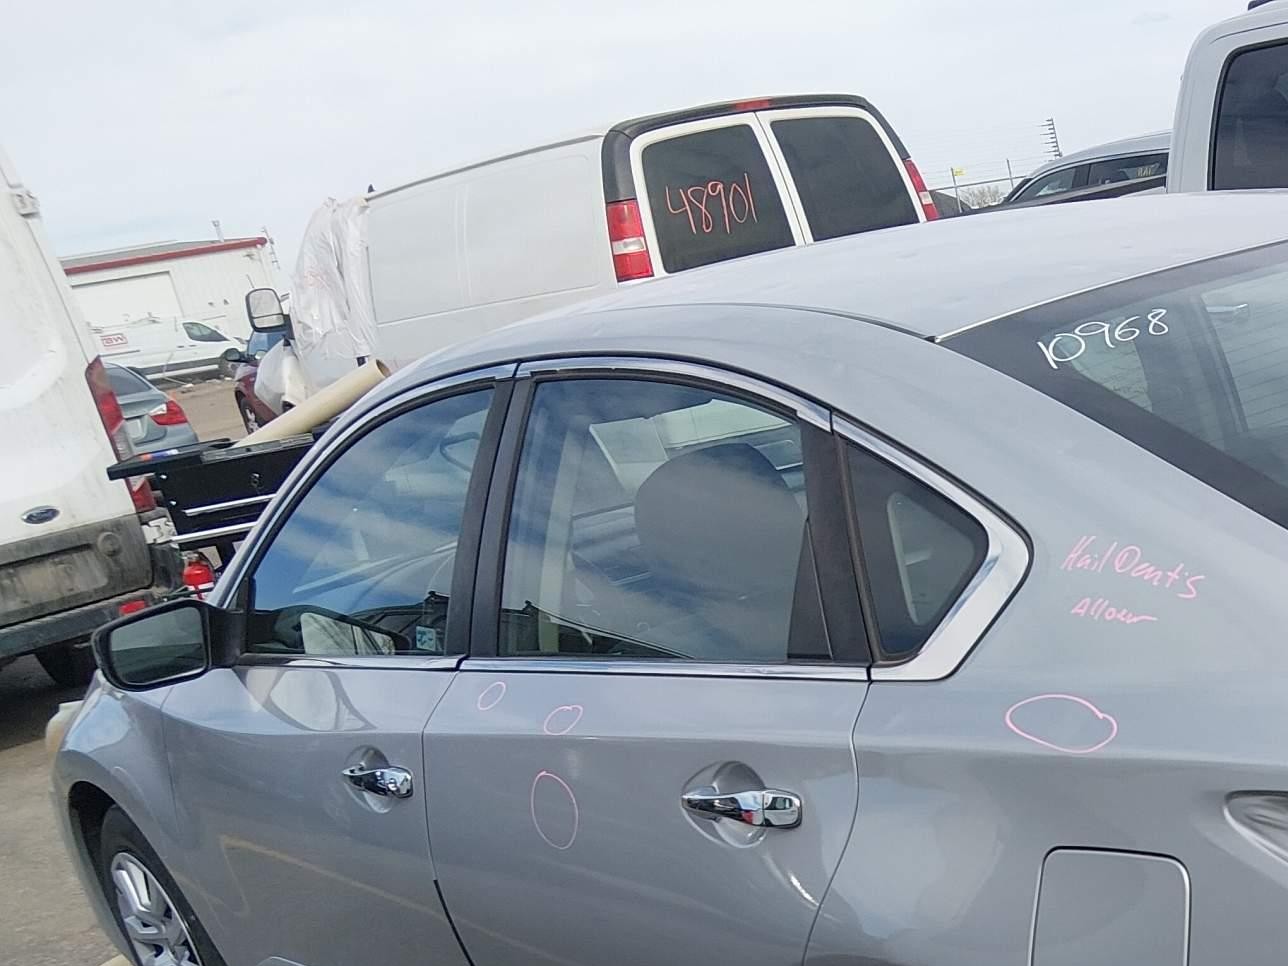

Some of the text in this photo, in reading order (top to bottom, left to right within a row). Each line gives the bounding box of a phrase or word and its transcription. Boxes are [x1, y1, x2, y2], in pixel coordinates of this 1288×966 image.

[665, 172, 758, 235] 48901
[1037, 308, 1169, 369] 10968
[1060, 535, 1118, 572] Hail
